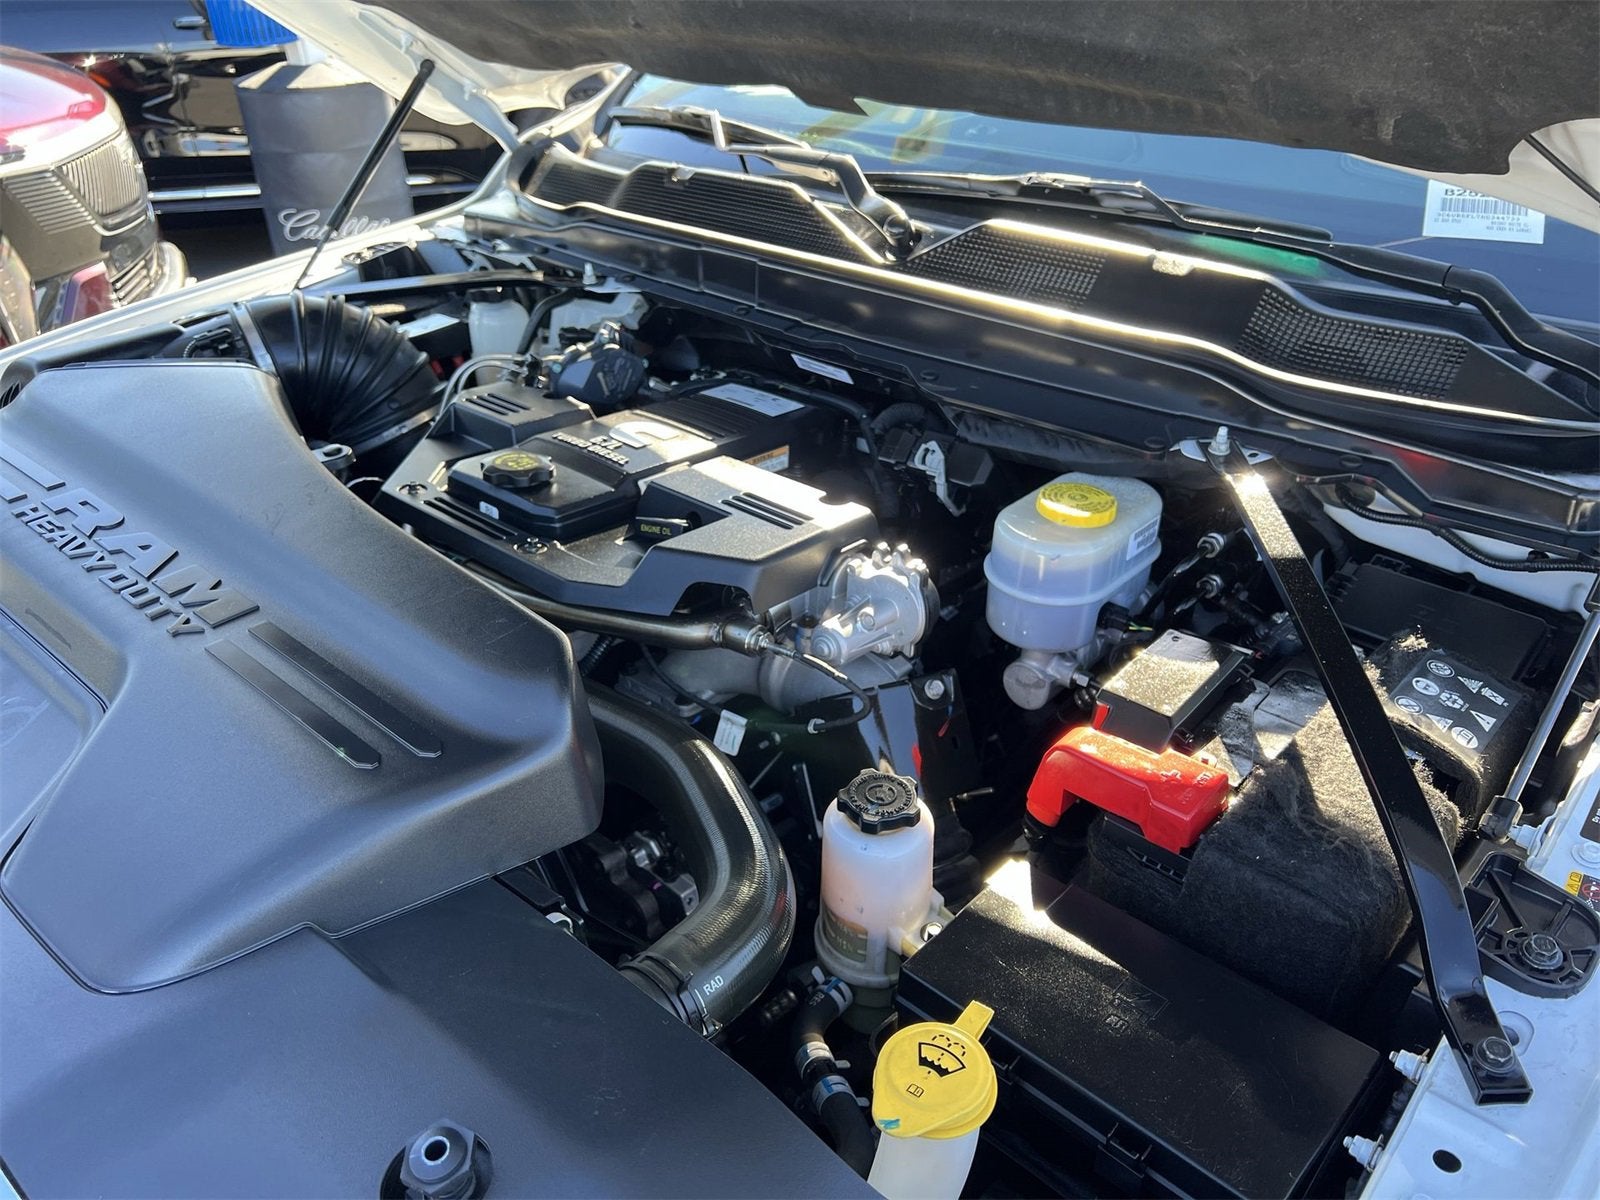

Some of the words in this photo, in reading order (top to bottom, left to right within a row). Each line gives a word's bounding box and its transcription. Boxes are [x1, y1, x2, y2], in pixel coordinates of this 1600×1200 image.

[41, 487, 260, 628] RAM
[640, 523, 661, 534] ENGINE
[11, 503, 117, 572] HEAVY
[98, 568, 206, 637] DUTY
[702, 975, 725, 996] RAD
